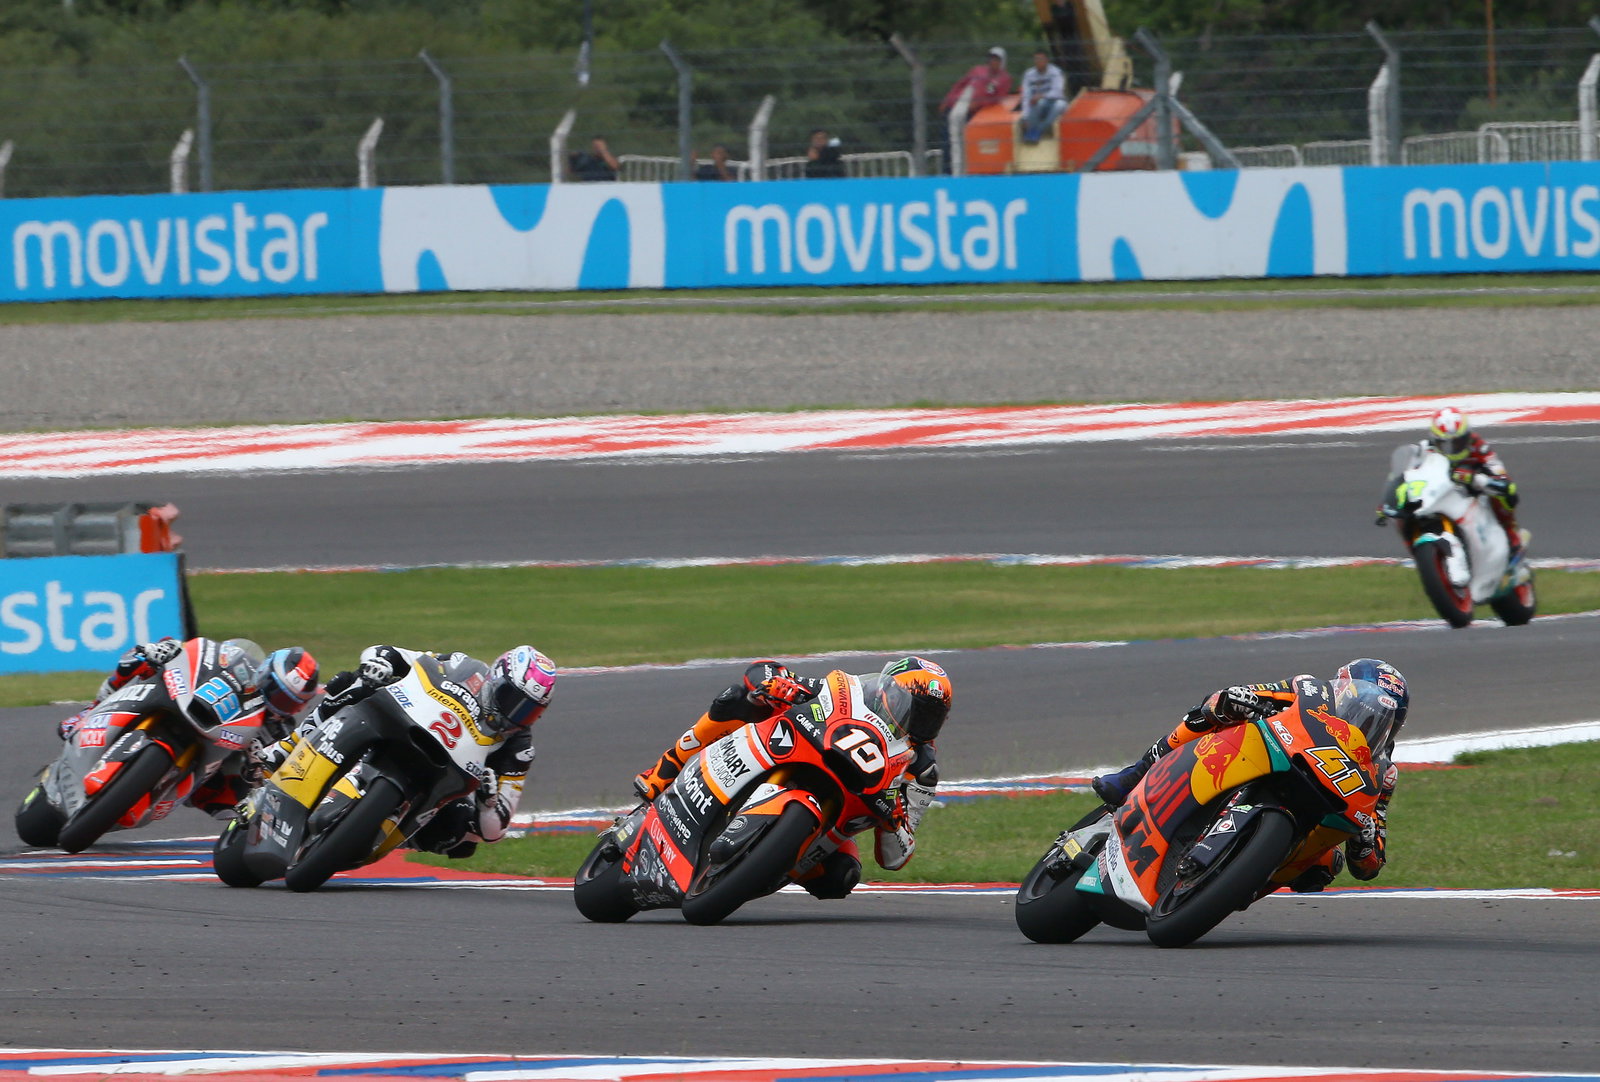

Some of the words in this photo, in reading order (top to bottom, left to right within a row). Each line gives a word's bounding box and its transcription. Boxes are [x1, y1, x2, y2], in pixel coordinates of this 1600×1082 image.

[13, 202, 328, 290] movistar
[725, 188, 1028, 275] movistar
[194, 677, 243, 723] 23
[388, 684, 414, 709] EXIDE
[427, 688, 480, 742] interwetten
[440, 680, 482, 717] Garage
[428, 710, 463, 750] 2
[795, 713, 815, 733] CAME
[875, 719, 893, 743] MAICO
[317, 741, 345, 764] plus
[1304, 746, 1367, 798] 41
